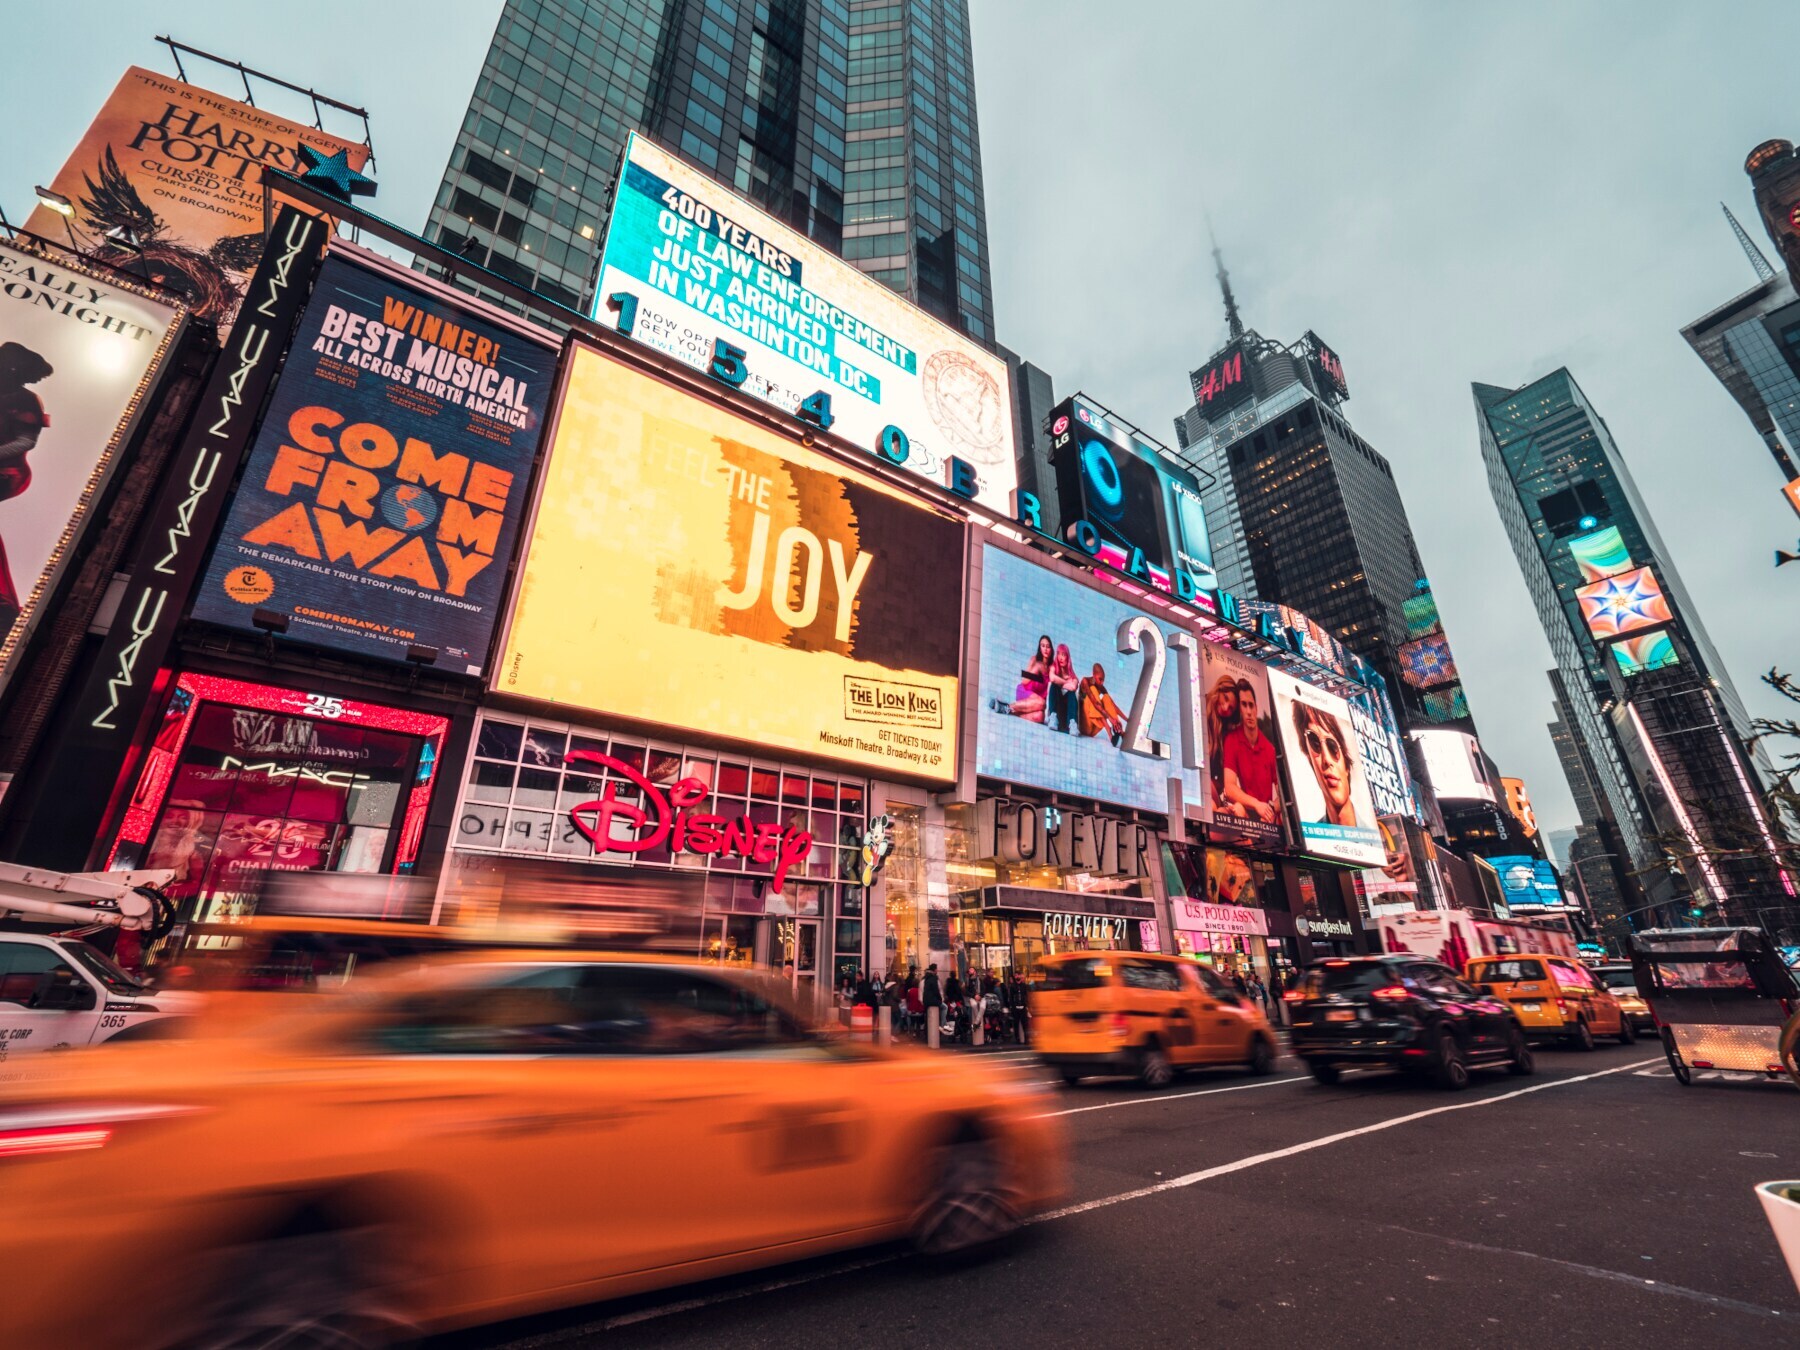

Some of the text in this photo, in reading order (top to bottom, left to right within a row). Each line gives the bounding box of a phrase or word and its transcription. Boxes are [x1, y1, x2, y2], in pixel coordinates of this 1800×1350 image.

[180, 91, 193, 100] IS
[198, 96, 227, 111] THE
[229, 108, 275, 127] STUFF
[276, 125, 297, 135] OF
[126, 121, 262, 184] POTT
[153, 102, 302, 178] HARRY
[141, 159, 282, 210] CURSED CHIL
[157, 175, 262, 212] PARTS ONE AND TWO
[192, 168, 244, 188] AND THE
[153, 188, 255, 223] ON BROADWAY
[661, 186, 792, 277] 400 YEARS
[652, 239, 827, 347] JUST ARRIVED
[657, 209, 909, 369] OF LAW ENFORCEMENT
[383, 296, 500, 368] WINNER!
[640, 319, 670, 339] GET
[677, 337, 707, 357] YOU
[642, 307, 712, 348] NOW OPE
[648, 260, 679, 296] IN
[839, 362, 873, 399] DC.
[320, 304, 529, 412] BEST MUSICAL
[1319, 346, 1345, 386] H&M
[312, 336, 526, 430] ALL ACROSS NORTH AMERICA
[1199, 352, 1242, 406] H&M
[1055, 432, 1070, 449] LG
[1089, 415, 1103, 430] LG
[288, 406, 514, 512] COME
[647, 432, 774, 510] FEEL THE
[240, 501, 493, 597] AWAY
[238, 546, 483, 613] THE REMARKABLE TRUE STORY NOW ON BROADWAY
[714, 512, 874, 644] JOY
[293, 616, 334, 630] Schoenfeld
[378, 635, 398, 645] WEST
[294, 605, 415, 639] COMEFROMAWAY.COM
[1227, 657, 1243, 670] POLO
[303, 693, 343, 718] 25
[850, 689, 873, 704] THE
[1117, 615, 1204, 770] 21
[878, 729, 942, 753] GET TICKETS TODAY!
[1349, 703, 1388, 748] WORLD
[819, 731, 854, 748] Minskoff
[886, 745, 921, 765] Broadway
[922, 754, 928, 764] &
[1368, 737, 1396, 775] YOUR
[985, 797, 1150, 879] FOREVER
[1216, 814, 1231, 823] LIVE
[1234, 818, 1278, 833] AUTHENTICALLY
[1494, 812, 1508, 841] 1500
[1042, 912, 1127, 940] FOREVER 21
[1185, 905, 1203, 918] U.S.
[1204, 907, 1230, 921] POLO
[1205, 922, 1244, 932] SINCE 1890
[1308, 918, 1353, 937] sunglass hut
[10, 1029, 33, 1040] CORP
[101, 1015, 127, 1028] 365
